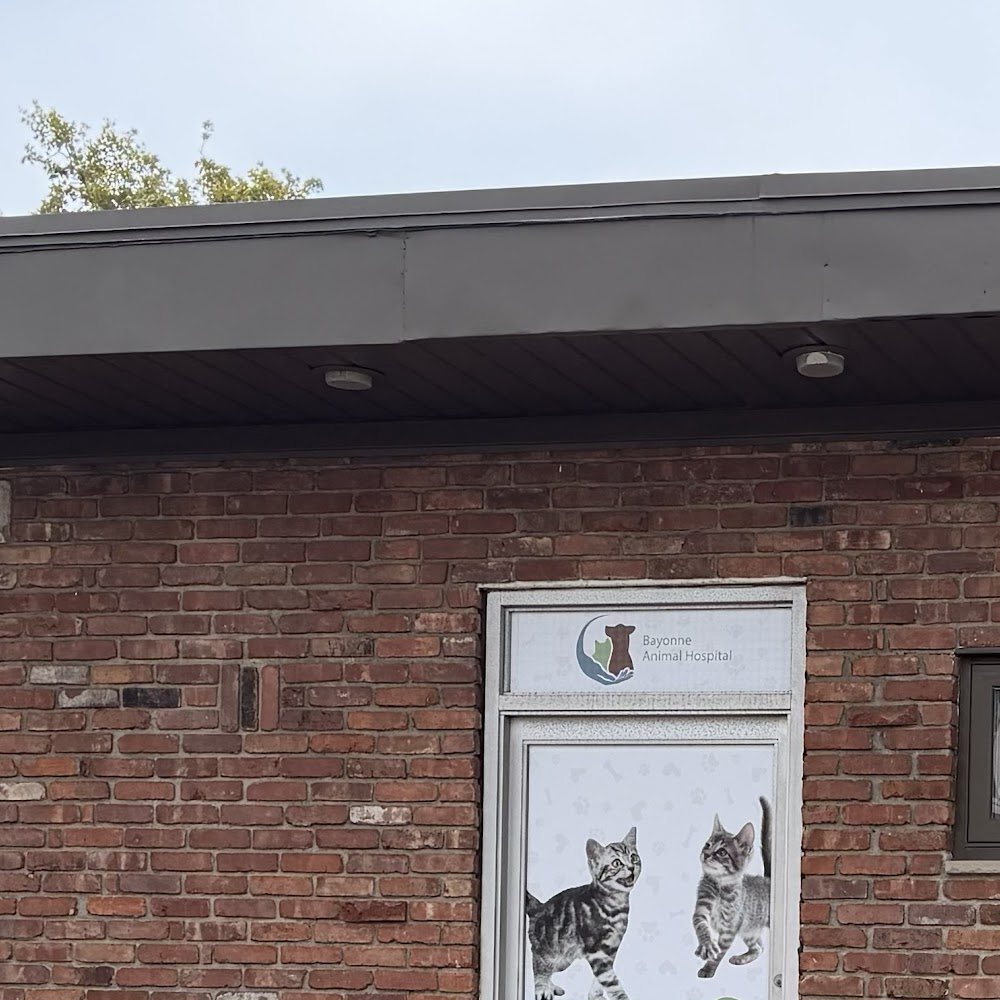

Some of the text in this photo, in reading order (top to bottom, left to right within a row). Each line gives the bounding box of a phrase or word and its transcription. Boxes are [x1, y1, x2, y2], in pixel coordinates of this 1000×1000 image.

[643, 635, 692, 648] Bayonne
[642, 650, 732, 663] Animal Hospital
